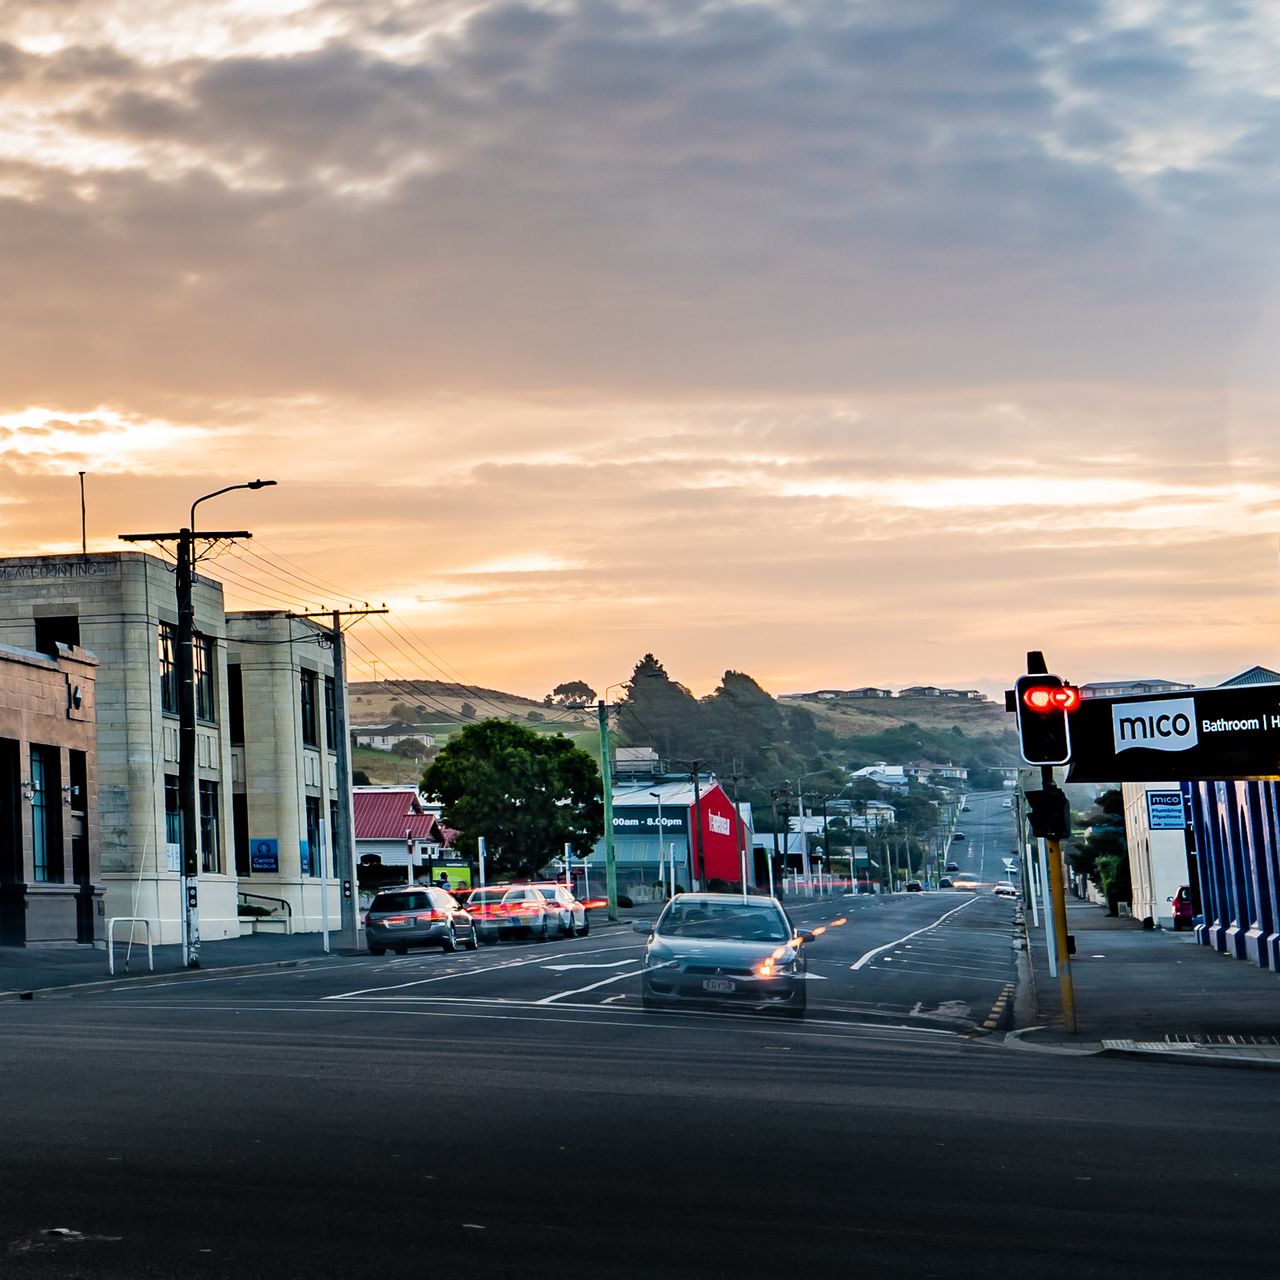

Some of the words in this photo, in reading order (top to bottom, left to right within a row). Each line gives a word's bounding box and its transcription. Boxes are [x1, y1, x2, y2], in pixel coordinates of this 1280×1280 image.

[15, 563, 96, 580] ACCOUNTING
[1119, 713, 1190, 740] mico
[1202, 718, 1259, 733] Bathroom
[646, 817, 682, 827] 8.00pm
